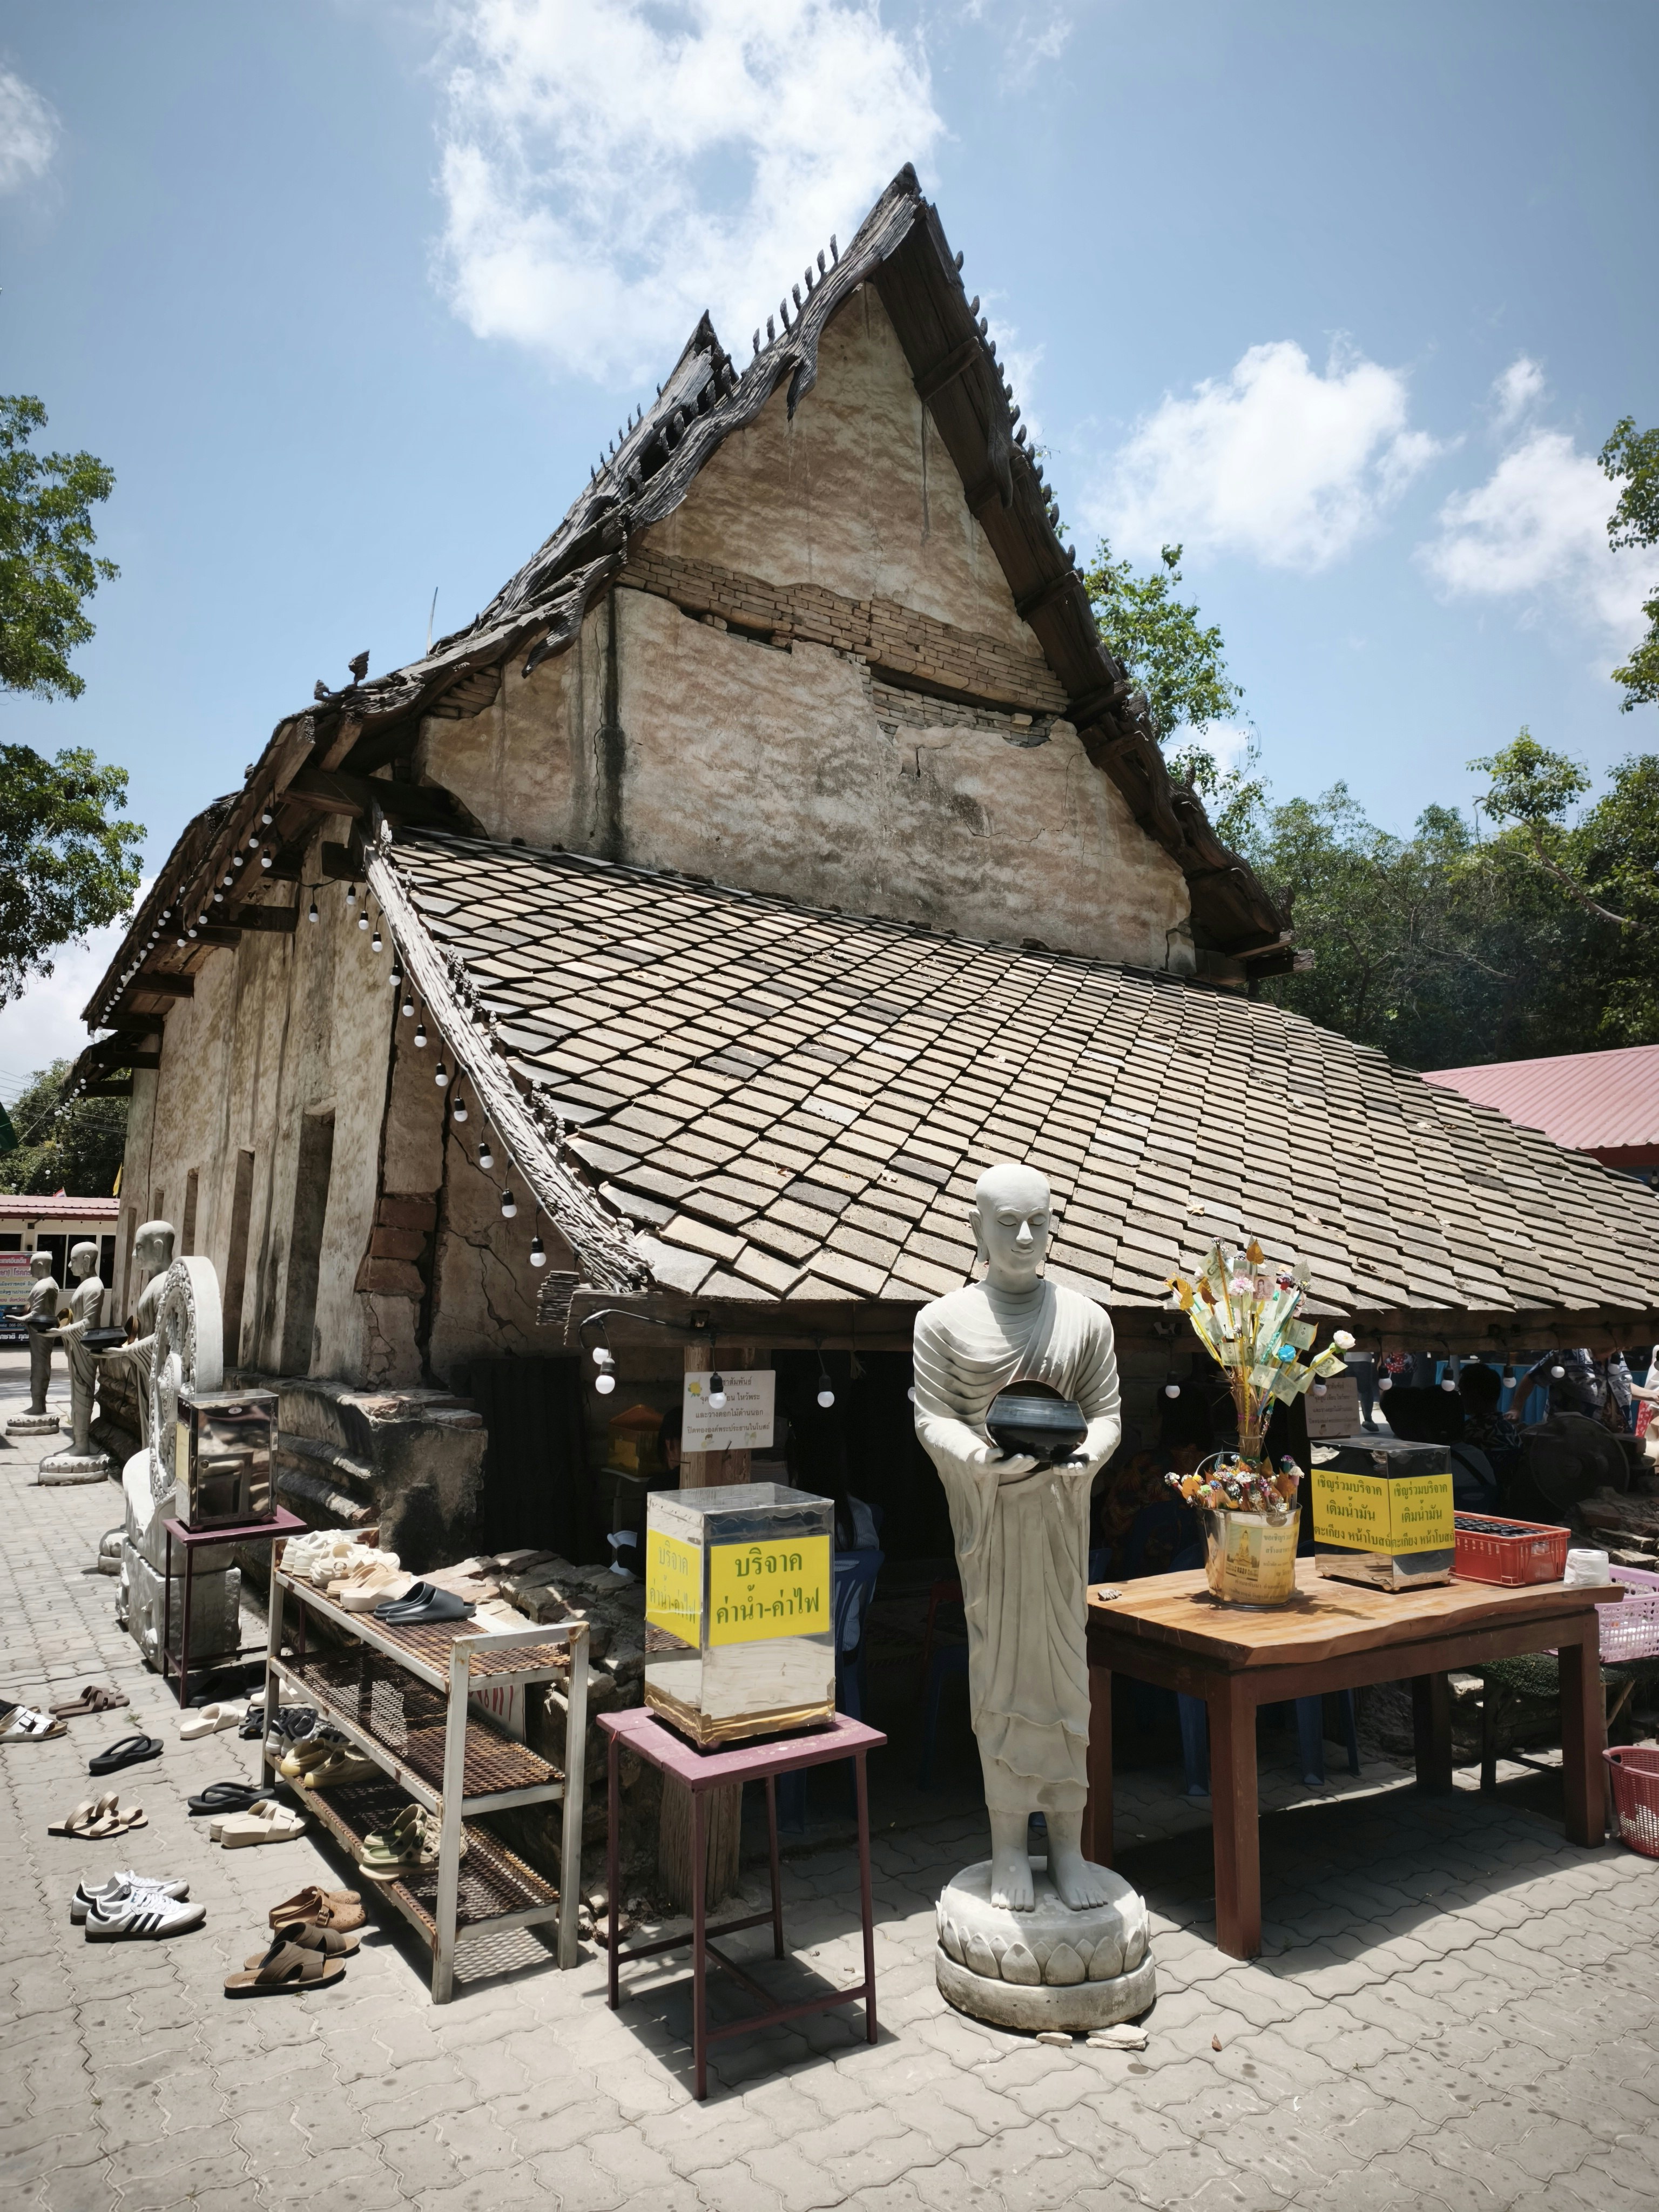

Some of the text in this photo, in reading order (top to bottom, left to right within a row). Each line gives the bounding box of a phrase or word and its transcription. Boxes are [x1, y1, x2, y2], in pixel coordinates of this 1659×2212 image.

[723, 1376, 752, 1385] ชาสัมพันธ์
[737, 1392, 761, 1401] ไหว้พระ
[1317, 1474, 1382, 1496] เชิญร่วมบริจาค
[1394, 1480, 1447, 1499] เชิญร่วมบริจาค
[1326, 1496, 1375, 1521] เติมน้ำมัน
[1401, 1499, 1442, 1523] เติมน้ำมัน
[1314, 1523, 1391, 1547] ตะเกียง หน้าโบสถ์
[1391, 1533, 1418, 1547] ตะเกียง
[659, 1540, 688, 1576] บริจาค
[735, 1547, 802, 1577] บริจาค
[650, 1574, 696, 1624] ค่าน้ำ-ค่าไฟ
[717, 1584, 819, 1624] ค่าน้ำ-ค่าไฟ
